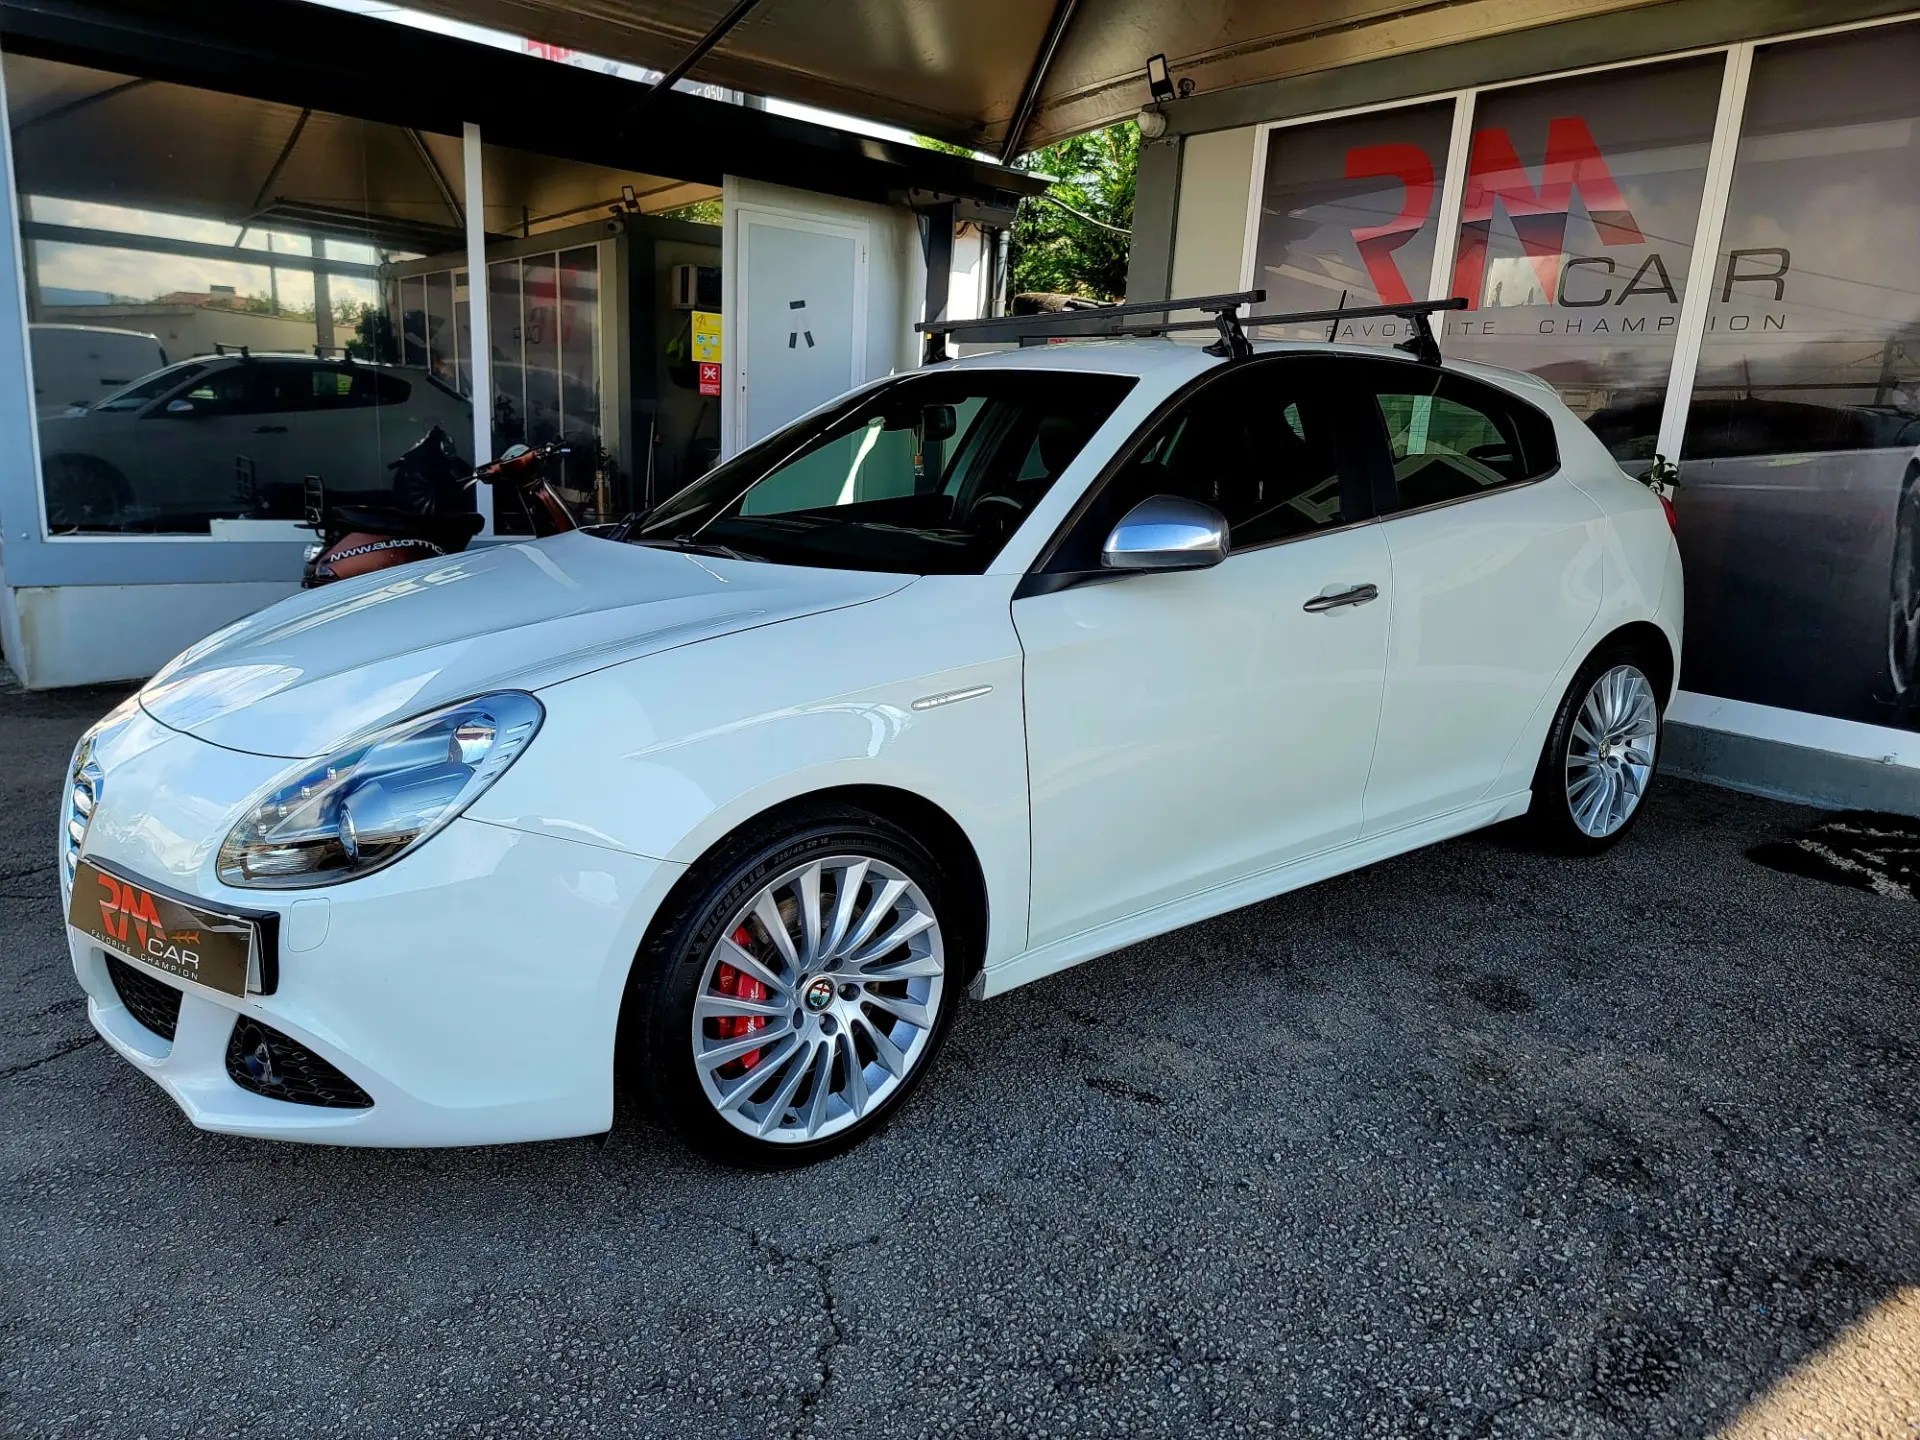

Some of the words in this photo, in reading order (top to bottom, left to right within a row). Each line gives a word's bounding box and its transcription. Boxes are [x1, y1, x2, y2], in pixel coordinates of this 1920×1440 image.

[1344, 116, 1646, 312] RM
[1557, 247, 1791, 308] CAR
[1538, 313, 1787, 335] CHAMPION
[330, 538, 446, 562] www.autormc
[98, 873, 168, 949] RM
[700, 864, 765, 939] MICHELIN
[91, 929, 132, 955] FAVORITE
[140, 953, 199, 981] CHAMPION
[148, 938, 200, 970] CAR
